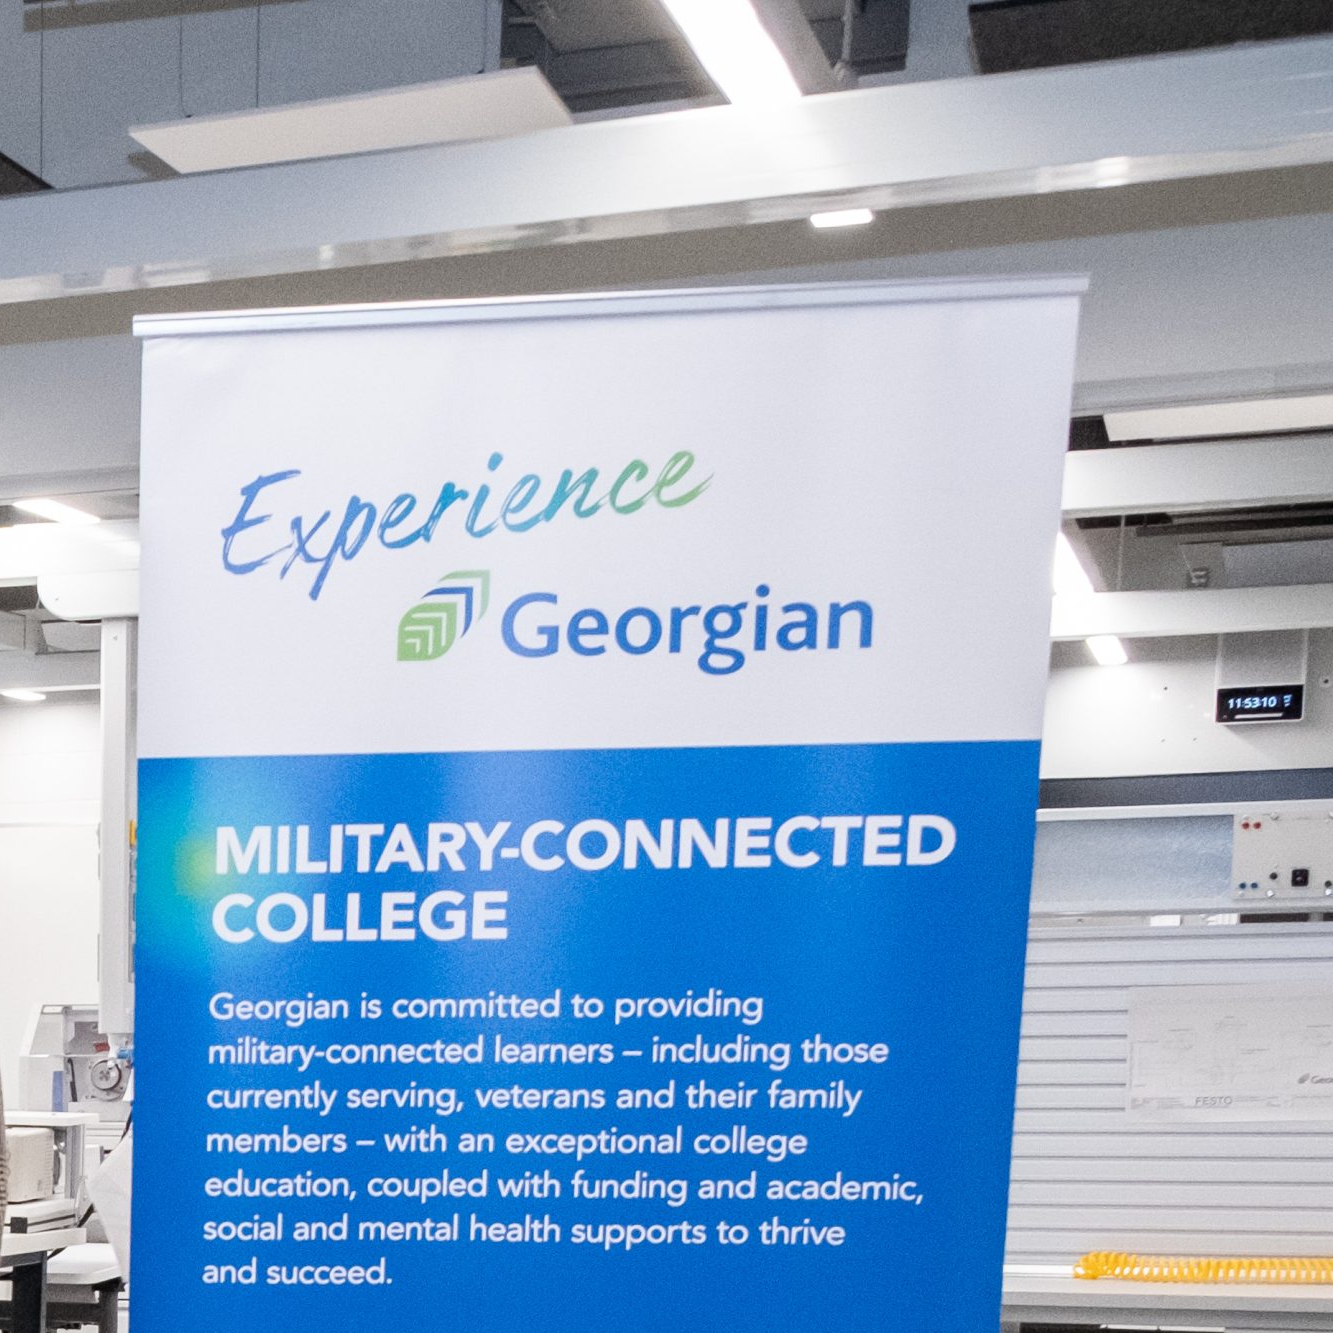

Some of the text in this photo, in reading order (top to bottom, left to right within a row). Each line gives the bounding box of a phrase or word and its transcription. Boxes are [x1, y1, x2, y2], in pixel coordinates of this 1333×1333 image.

[220, 449, 715, 601] Experience
[500, 583, 875, 677] Georgian
[214, 814, 957, 877] MILITARY-CONNECTED
[211, 890, 509, 943] COLLEGE
[209, 988, 763, 1028] Georgian is committed to providing
[208, 1034, 484, 1072] military-connected
[494, 1034, 614, 1064] learners
[652, 1034, 791, 1071] including
[801, 1033, 889, 1063] those
[206, 1079, 863, 1117] currently serving, veterans and their family
[206, 1124, 347, 1154] members
[384, 1124, 447, 1153] with
[458, 1133, 495, 1153] an
[505, 1125, 682, 1161] exceptional
[693, 1125, 808, 1163] college
[204, 1168, 923, 1207] education, coupled with funding and academic,
[203, 1213, 846, 1251] social and mental health supports to thrive
[202, 1256, 394, 1286] and succeed.
